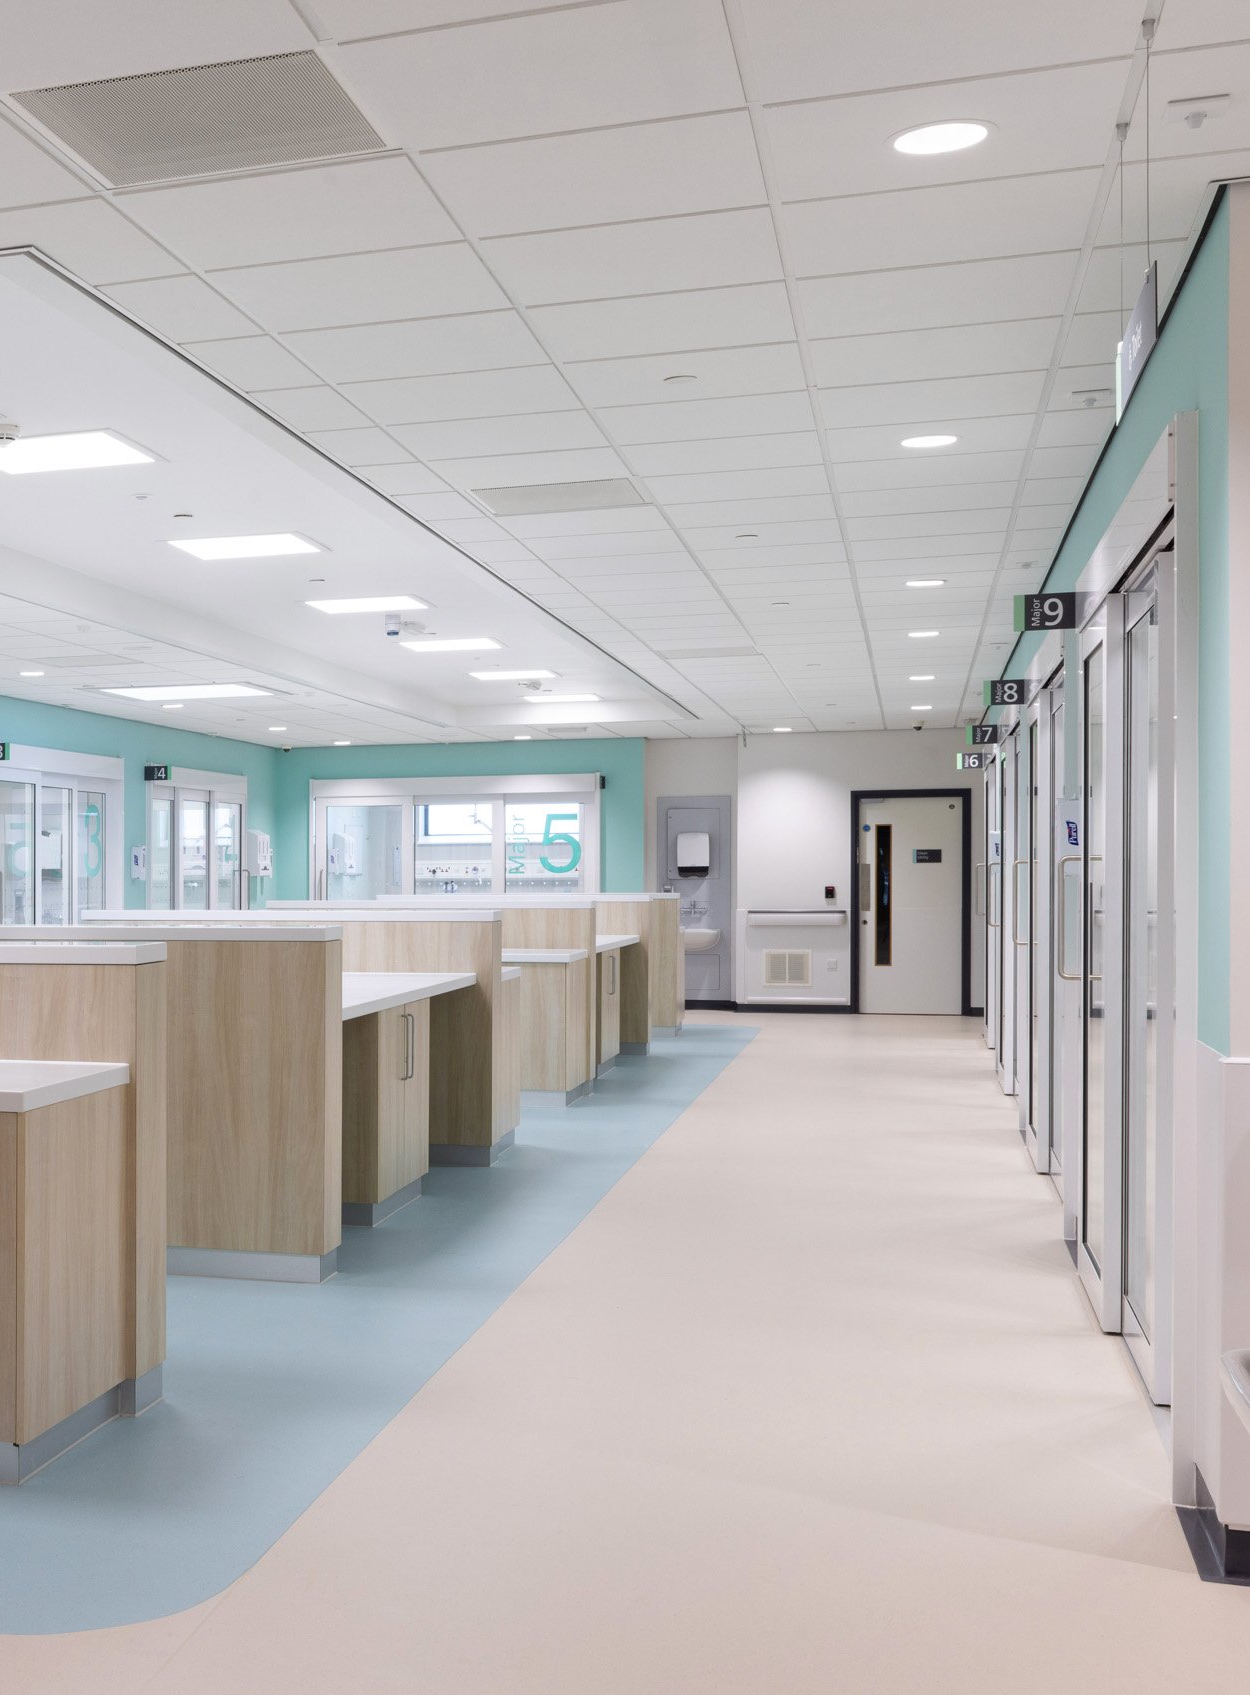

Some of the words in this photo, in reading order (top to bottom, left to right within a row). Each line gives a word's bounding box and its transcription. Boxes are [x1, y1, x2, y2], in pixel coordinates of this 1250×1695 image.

[1031, 598, 1042, 627] Major
[1043, 597, 1064, 626] 9
[994, 683, 1004, 703] Major
[1003, 682, 1018, 703] 8
[981, 727, 993, 743] 7
[969, 754, 979, 768] 6
[157, 767, 166, 779] 4
[83, 804, 101, 878] 3
[508, 814, 530, 875] Major
[539, 813, 582, 874] 5
